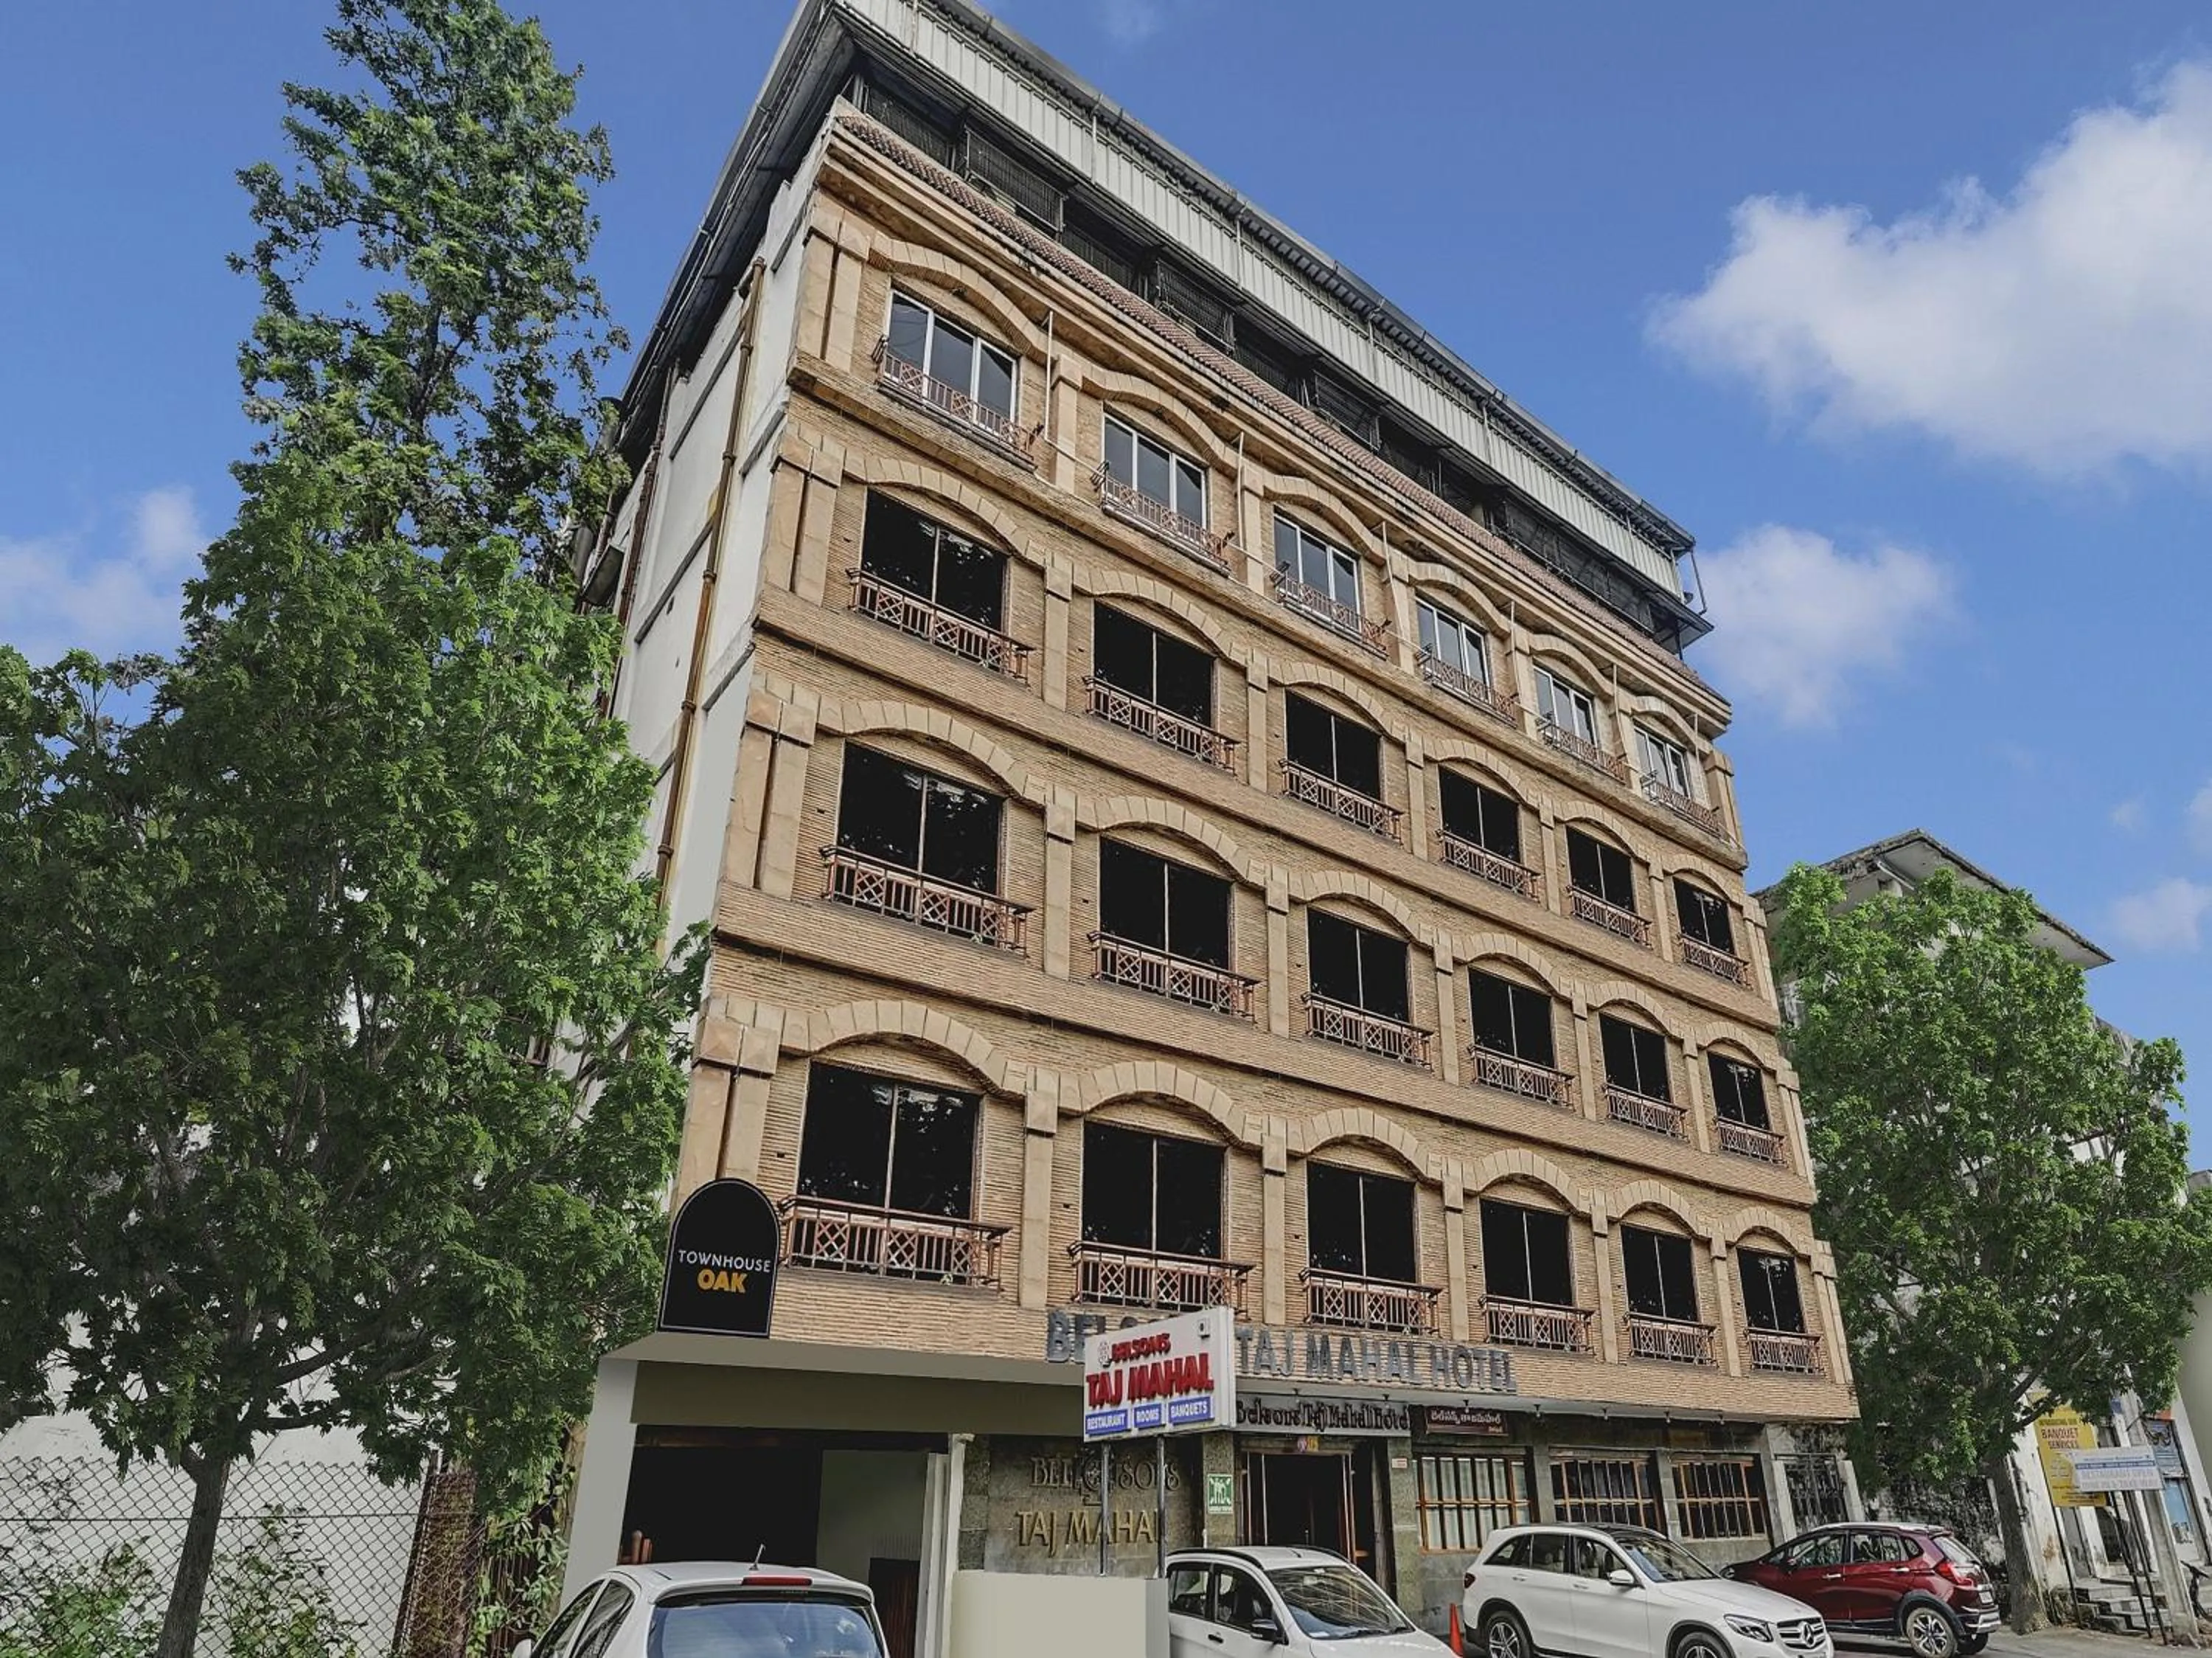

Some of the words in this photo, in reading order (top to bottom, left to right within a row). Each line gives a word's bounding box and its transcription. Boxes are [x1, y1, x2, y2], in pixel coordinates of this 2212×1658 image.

[678, 1249, 771, 1273] TOWNHOUSE
[697, 1268, 747, 1294] OAK
[1235, 1327, 1293, 1376] TAJ
[1305, 1333, 1425, 1385] MAHAL
[1430, 1343, 1517, 1392] HOTEL
[1086, 1368, 1123, 1408] TAJ
[1127, 1353, 1214, 1404] MAHAL
[1086, 1412, 1126, 1431] RESTAURANT
[1135, 1407, 1160, 1423] ROOMS
[1170, 1401, 1208, 1419] BANQUETS
[2040, 1427, 2078, 1439] BANQUET
[1015, 1509, 1057, 1558] TAJ
